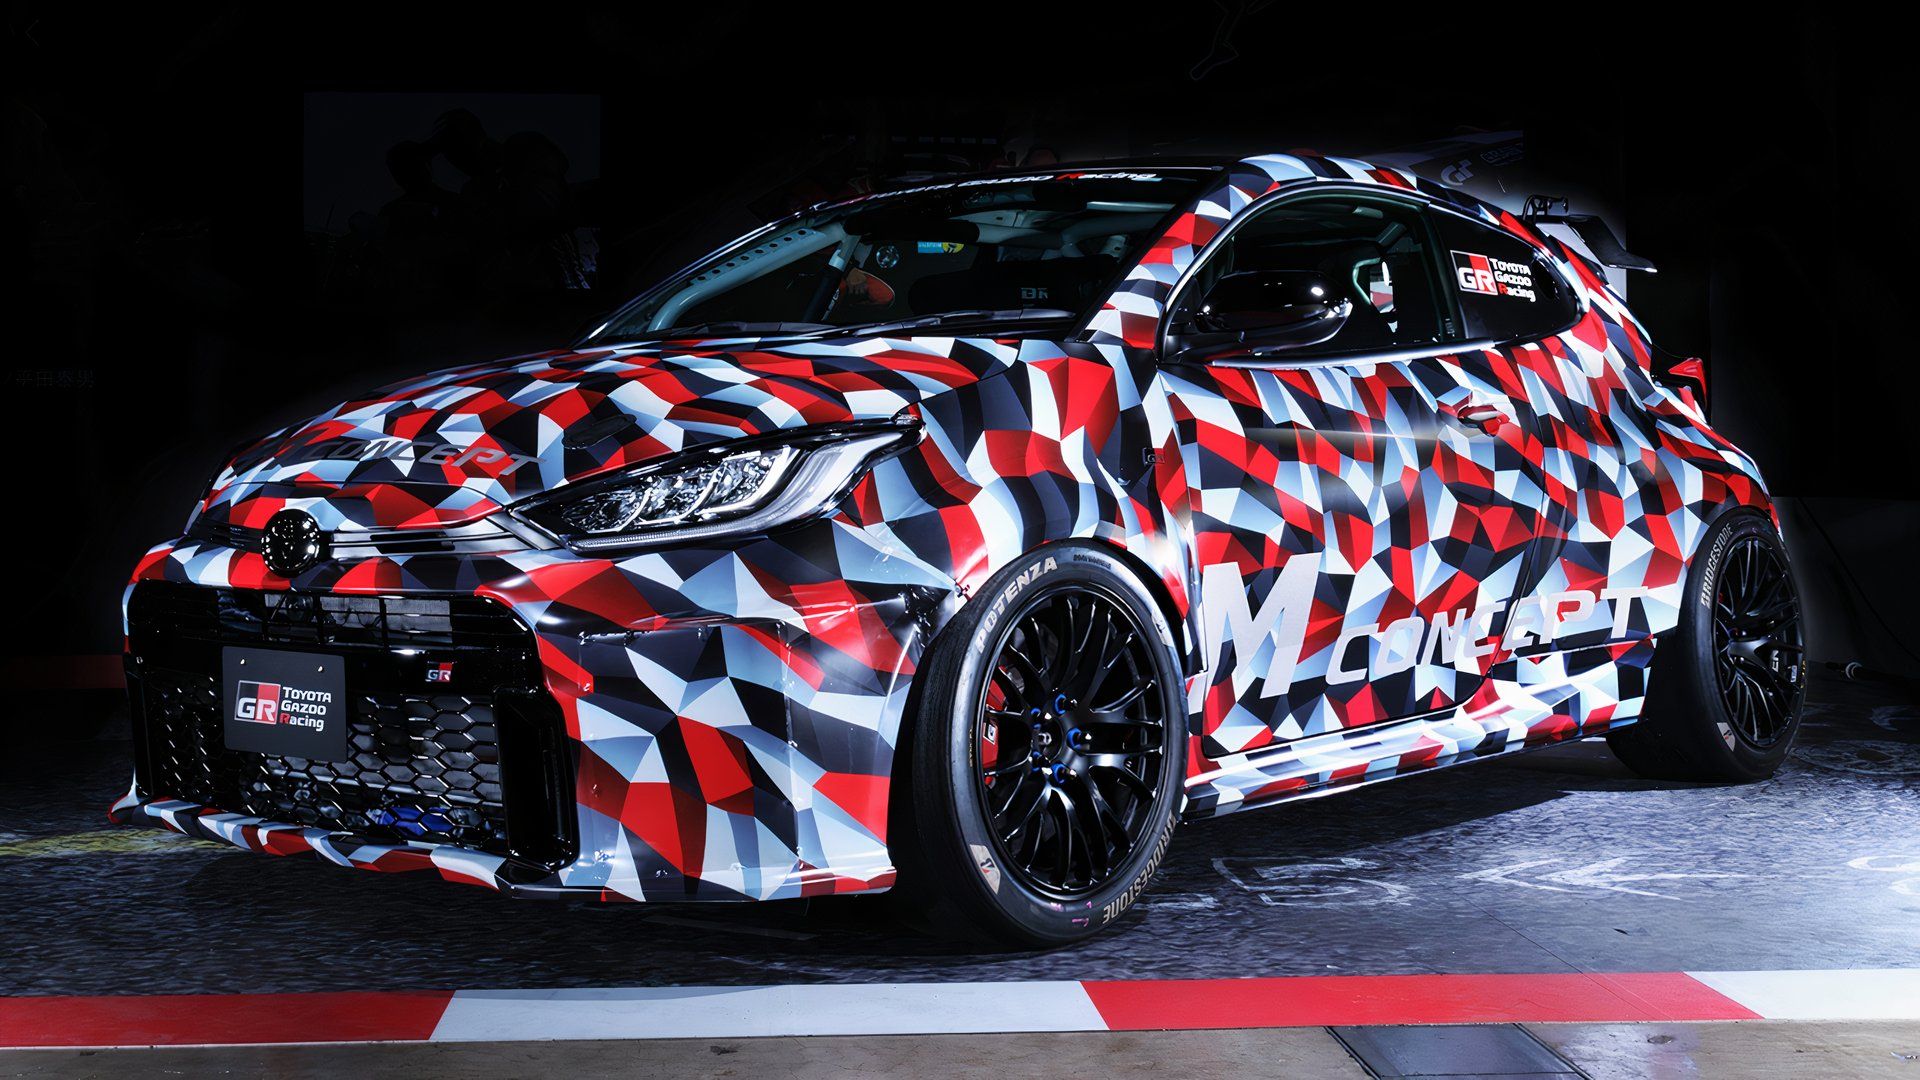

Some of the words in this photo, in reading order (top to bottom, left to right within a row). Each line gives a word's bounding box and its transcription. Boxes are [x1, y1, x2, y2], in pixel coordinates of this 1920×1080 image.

[1489, 257, 1531, 275] TOYOTA
[1493, 270, 1532, 287] GAZOO
[1496, 281, 1537, 302] Racing
[301, 438, 547, 476] CONCEPT
[1701, 523, 1733, 609] BRIDGESTONE
[974, 556, 1058, 654] POTENZA
[1188, 551, 1323, 714] M
[1325, 586, 1648, 685] CONCEPT
[282, 686, 332, 704] TOYOTA
[236, 697, 277, 722] GR
[280, 700, 327, 716] GAZOO
[279, 713, 325, 732] Racing
[1102, 810, 1177, 925] BRIDGESTONE
